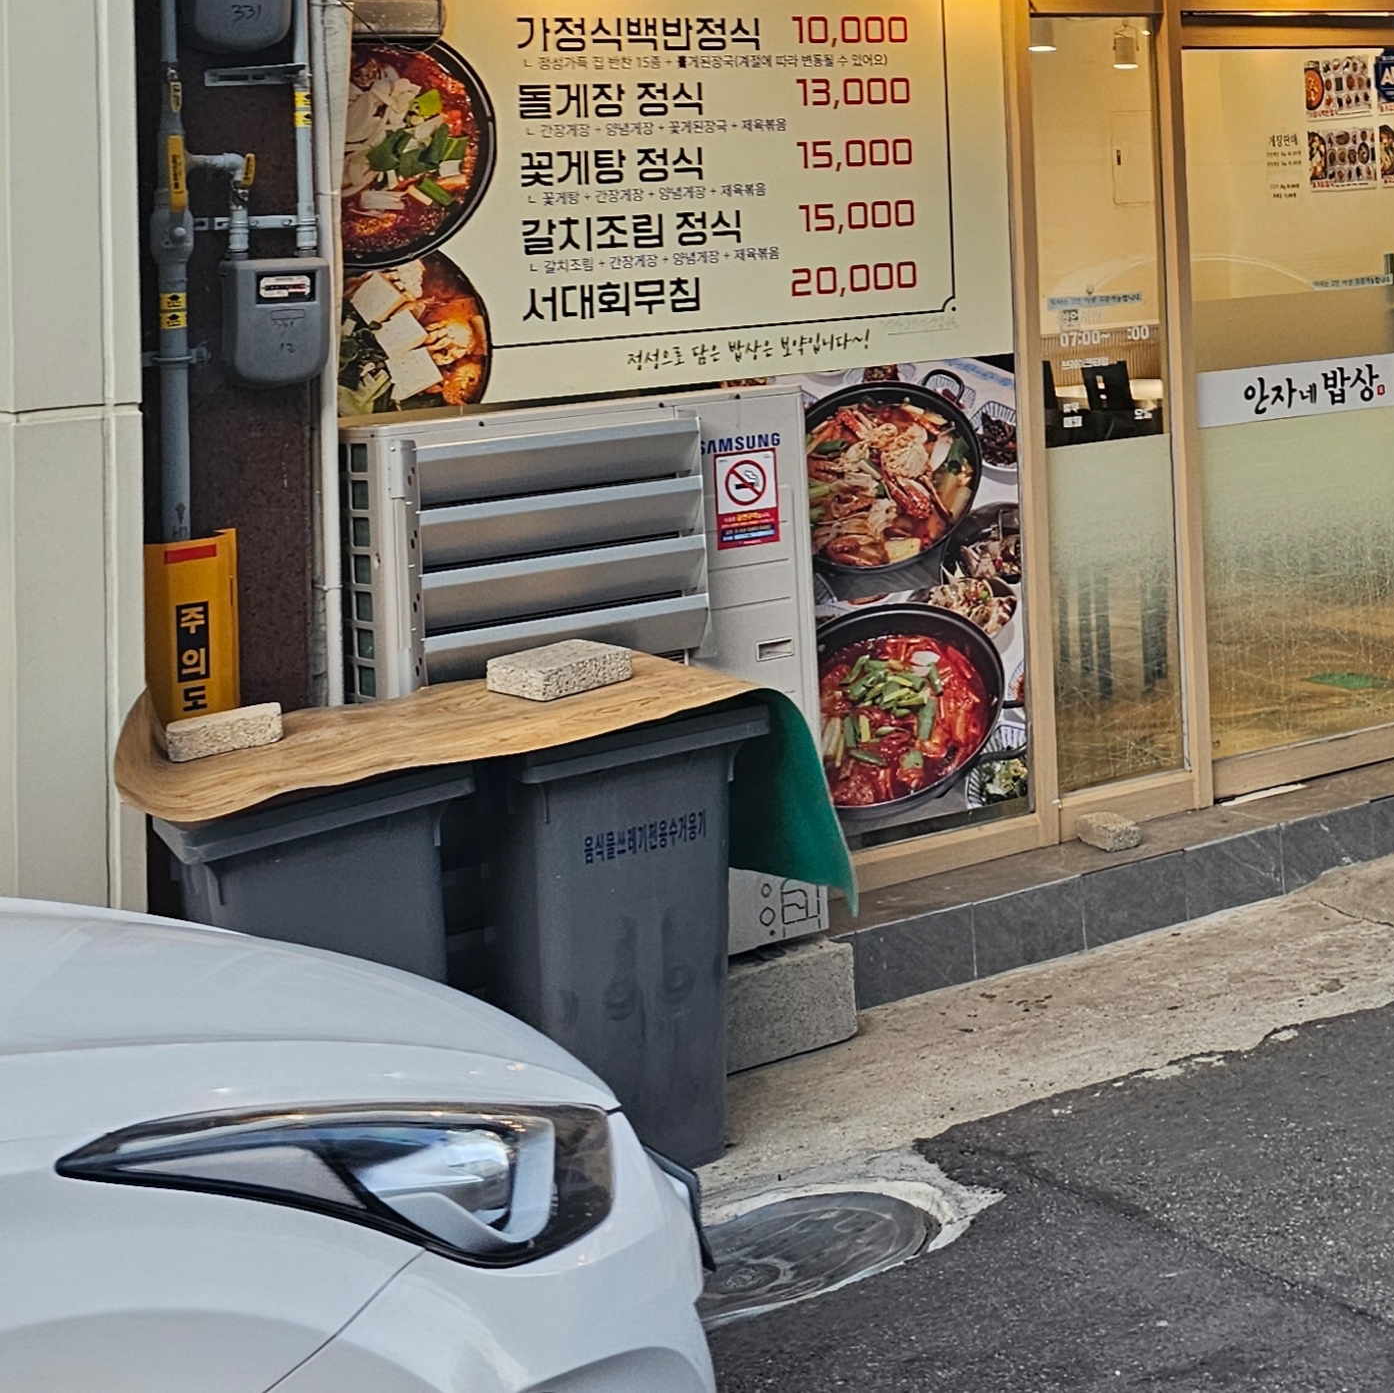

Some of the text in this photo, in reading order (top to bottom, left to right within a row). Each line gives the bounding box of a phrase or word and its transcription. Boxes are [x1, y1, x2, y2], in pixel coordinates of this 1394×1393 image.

[516, 15, 908, 52] 가정식백반정식 10,000
[538, 56, 588, 70] 정성가득
[608, 55, 632, 70] 반찬
[637, 55, 661, 70] 15종
[518, 77, 910, 119] 돌게장 정식 13,000
[540, 123, 590, 138] 간장게장
[606, 122, 655, 137] 양념게장
[669, 120, 727, 134] 꽃게된장국
[742, 118, 787, 132] 제육볶음
[521, 139, 912, 187] 꽃게탕 정식 15,000
[542, 191, 580, 206] 꽃게탕
[595, 188, 644, 203] 간장게장
[658, 186, 706, 201] 양념게장
[720, 182, 767, 197] 제육볶음
[522, 200, 916, 255] 갈치조림 정식 15,000
[544, 258, 594, 274] 갈치조림
[609, 254, 658, 270] 간장게장
[673, 251, 720, 266] 양념게장
[734, 246, 780, 262] 제육볶음
[523, 261, 918, 322] 서대회무침 20,000
[627, 346, 685, 371] 정성으로
[691, 343, 720, 366] 담은
[727, 337, 773, 363] 밥상은
[1244, 364, 1380, 414] 안자네 밥상
